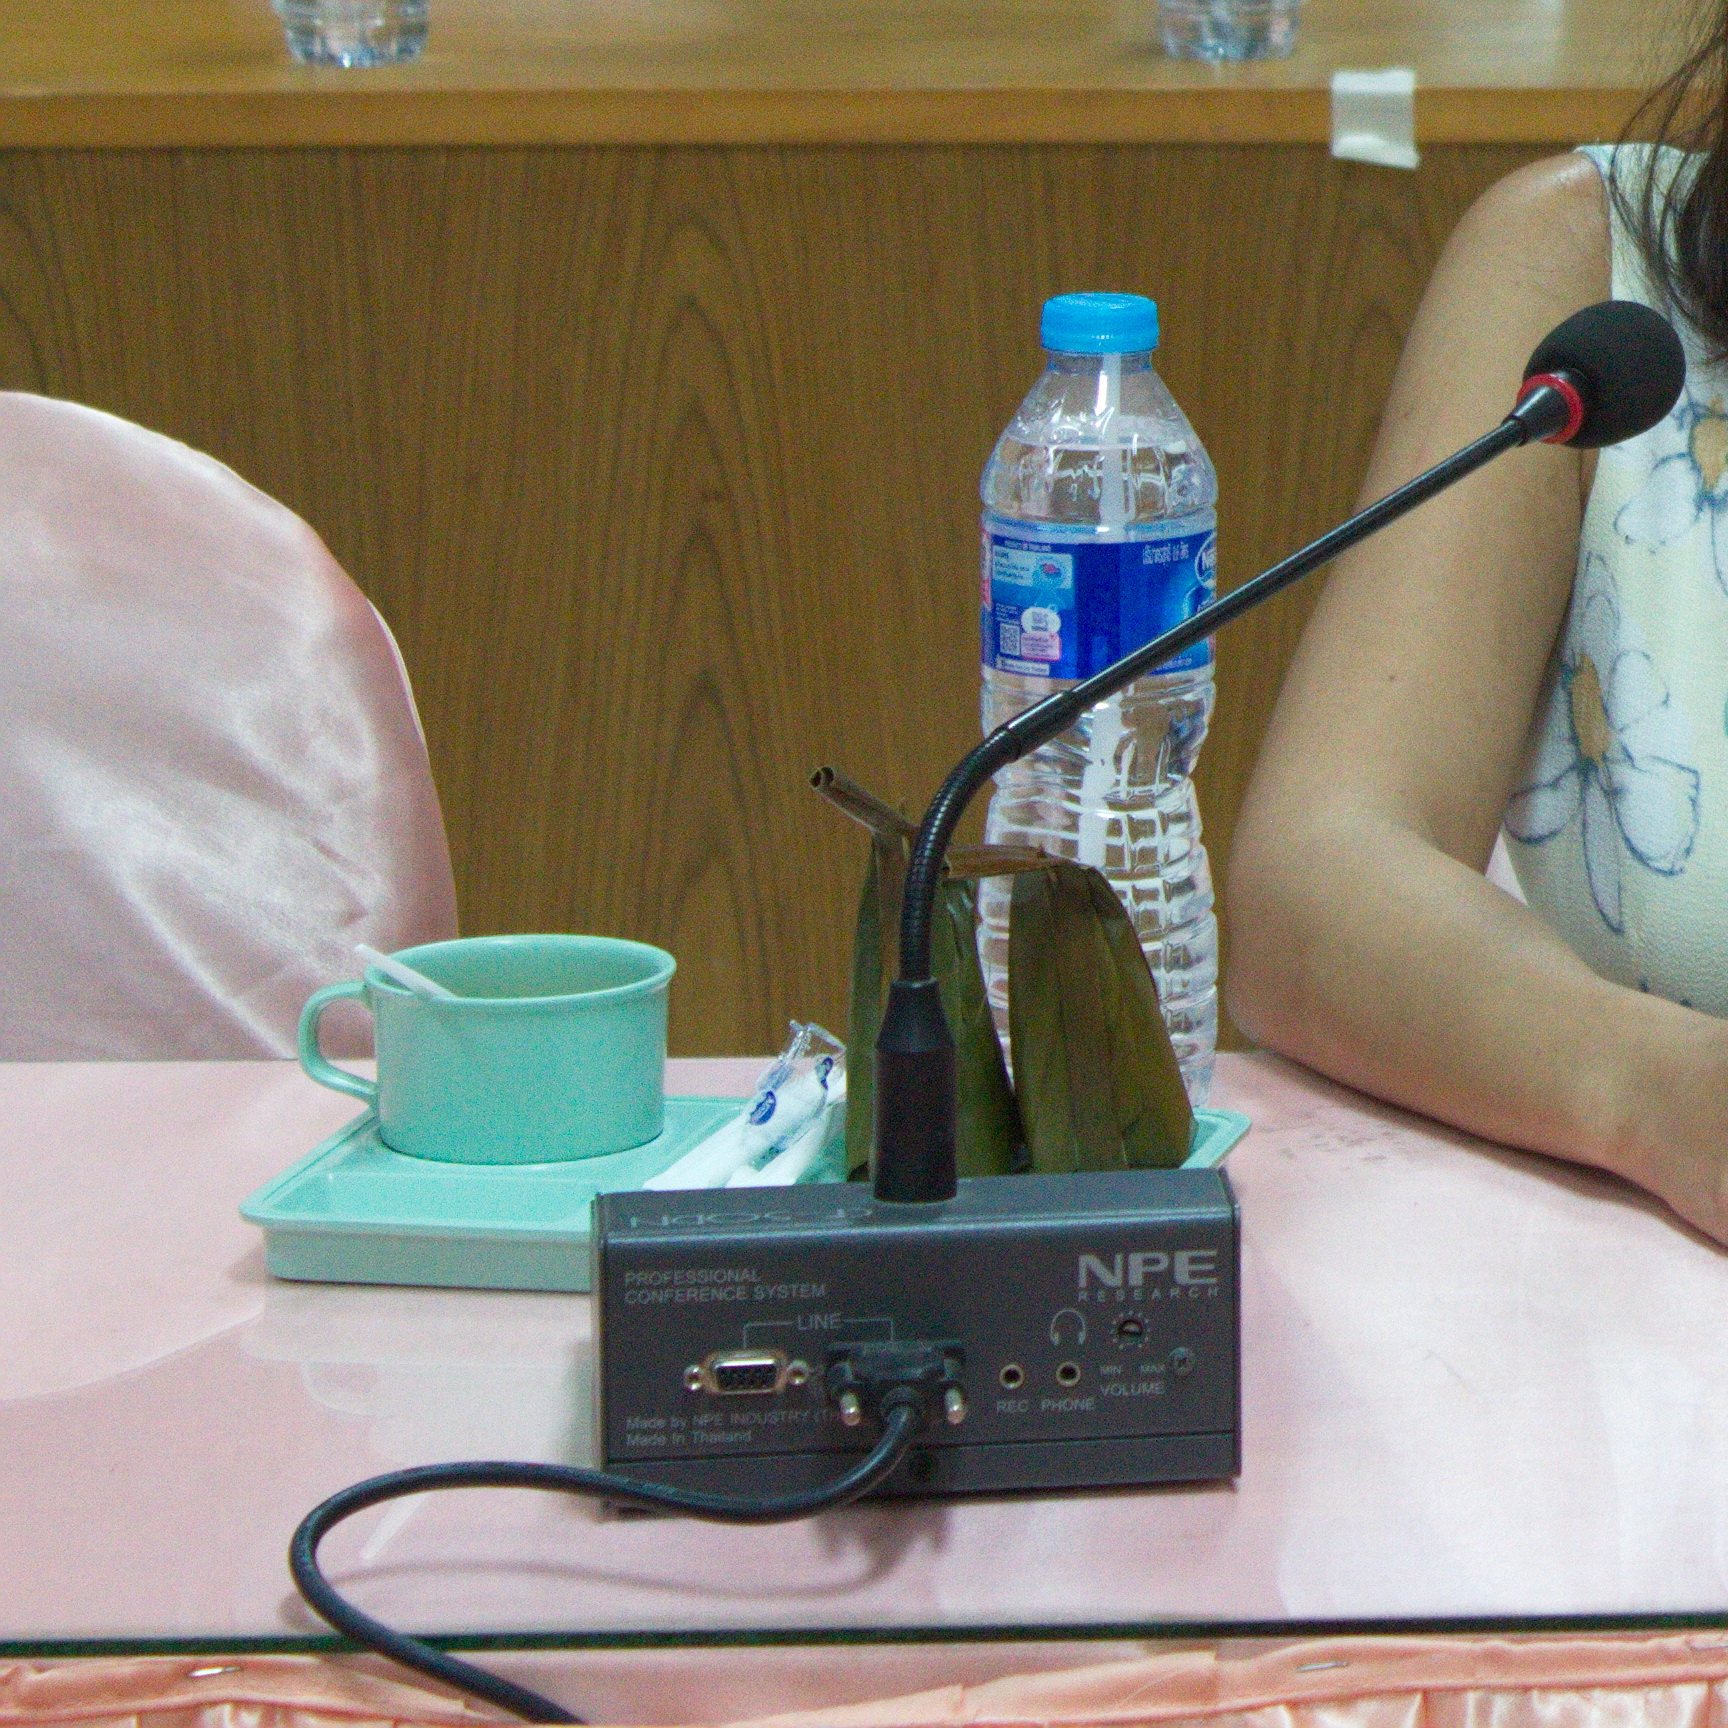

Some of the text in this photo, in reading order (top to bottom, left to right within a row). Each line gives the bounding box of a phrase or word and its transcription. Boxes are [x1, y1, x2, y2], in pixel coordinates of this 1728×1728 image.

[624, 1269, 762, 1285] PROFESSIONAL
[1078, 1250, 1218, 1288] NPE
[624, 1283, 826, 1305] CONFERENCE SYSTEM
[1078, 1287, 1219, 1303] RESEARCH
[797, 1312, 841, 1330] LINE
[1100, 1381, 1166, 1397] VOLUME
[996, 1397, 1096, 1414] REC PHONE
[625, 1415, 667, 1431] Made
[670, 1416, 688, 1432] by
[625, 1432, 667, 1447] Made
[692, 1429, 752, 1444] Thailand
